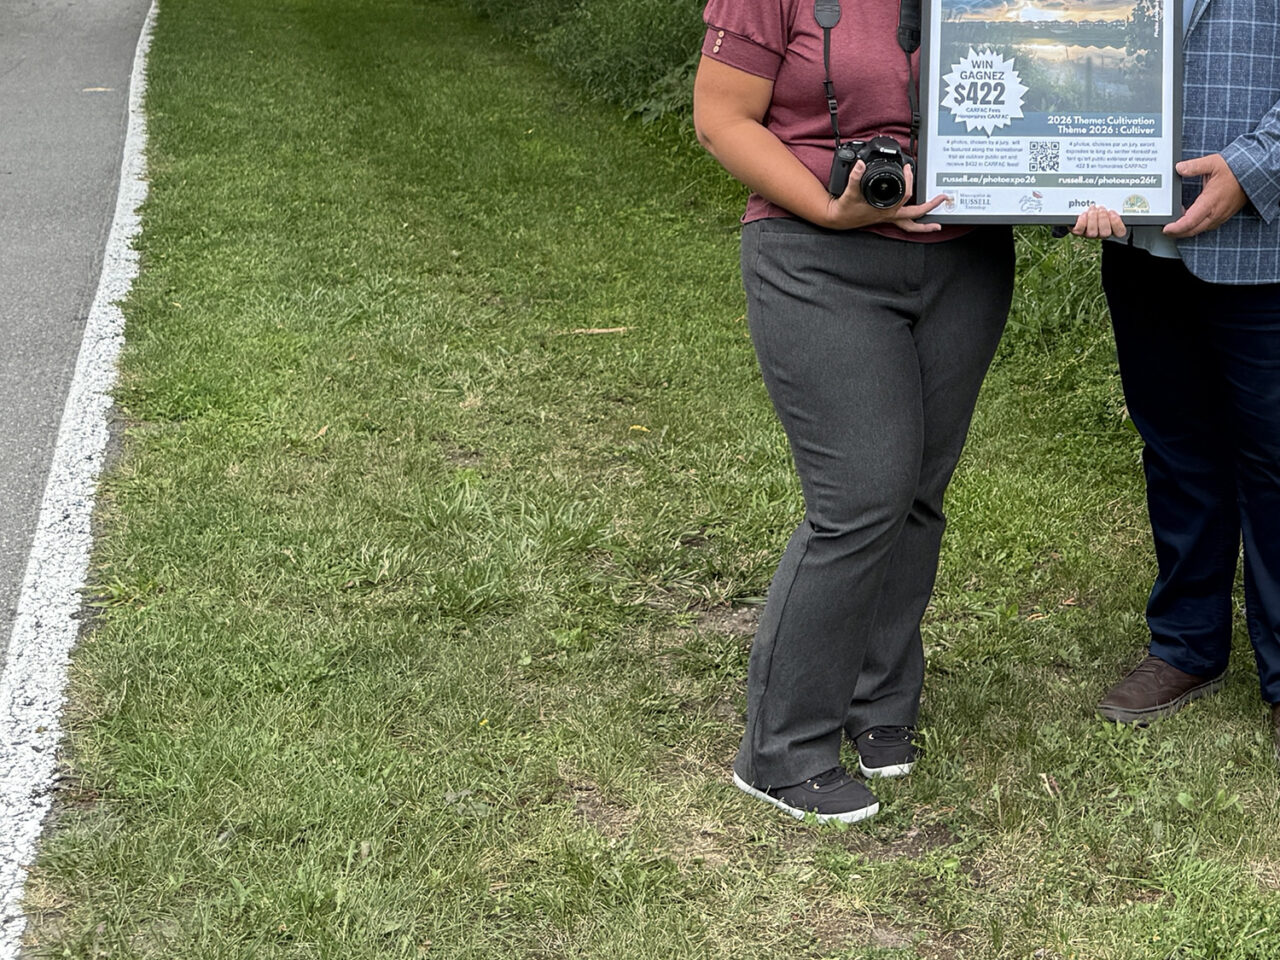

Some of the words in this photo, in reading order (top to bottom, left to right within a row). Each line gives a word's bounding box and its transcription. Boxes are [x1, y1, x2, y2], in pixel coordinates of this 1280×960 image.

[971, 60, 993, 69] WIN
[960, 71, 1005, 80] GAGNEZ
[954, 82, 1006, 106] $422
[1048, 116, 1072, 125] 2026
[1074, 116, 1105, 125] Theme:
[1107, 116, 1155, 125] Cultivation
[1057, 125, 1087, 134] Thème
[1089, 125, 1114, 134] 2026
[1120, 125, 1155, 134] Cultiver
[942, 175, 1036, 185] russell.ca/photoexpo26
[1058, 176, 1157, 186] russell.ca/photoexpo26fr
